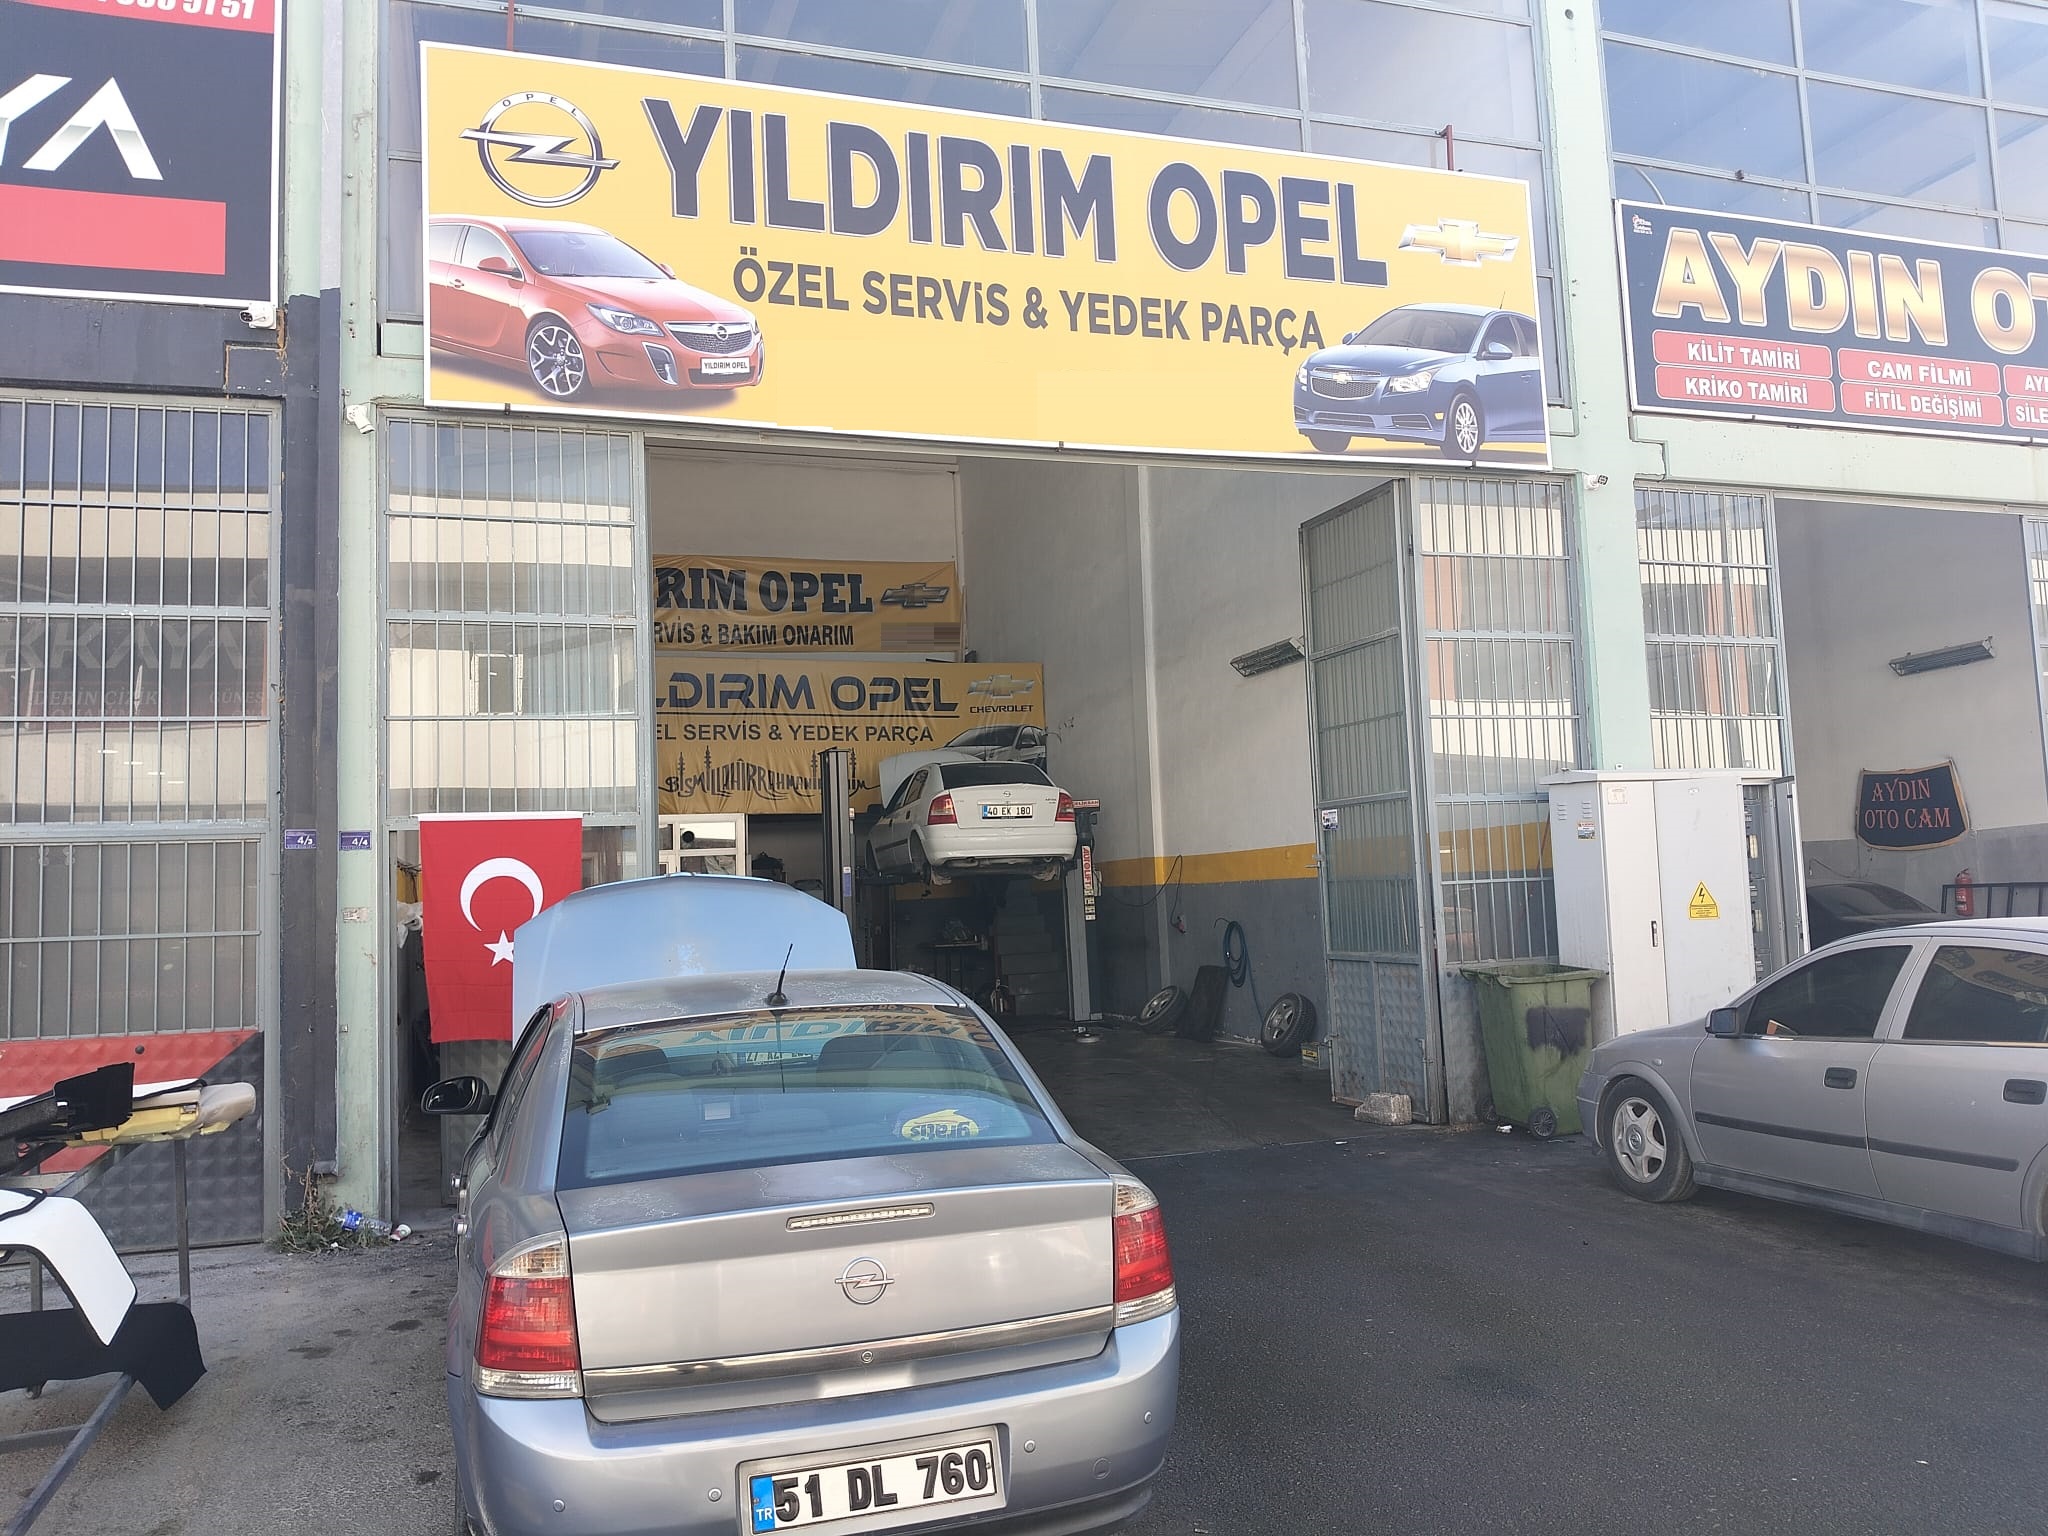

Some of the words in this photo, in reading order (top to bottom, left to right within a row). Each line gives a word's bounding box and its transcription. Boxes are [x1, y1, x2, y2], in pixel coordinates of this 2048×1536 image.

[502, 93, 578, 117] OPEL
[640, 97, 1118, 263] YILDIRIM
[1148, 161, 1390, 288] OPEL
[1651, 226, 1948, 347] AYDIN
[733, 246, 849, 310] ÖZEL
[1022, 286, 1048, 329] &
[1058, 289, 1191, 341] YEDEK
[1201, 303, 1325, 357] PARÇA
[732, 361, 748, 369] OPEL
[1687, 340, 1735, 363] KİLİT
[1740, 347, 1801, 370] TAMİRİ
[1867, 361, 1912, 381] CAM
[1918, 363, 1972, 386] FİLMİ
[1685, 375, 1743, 398] KRİKO
[1747, 381, 1808, 404] TAMİRİ
[1864, 388, 1907, 411] FİTİL
[1911, 393, 1982, 420] DEĞİŞİMİ
[758, 570, 874, 613] OPEL
[701, 624, 712, 644] &
[783, 624, 854, 646] ONARIM
[830, 676, 960, 712] OPEL
[969, 704, 1034, 714] CHEVROLET
[683, 720, 761, 741] SERVİS
[768, 724, 783, 741] &
[788, 724, 859, 742] YEDEK
[866, 725, 934, 745] PARÇA
[1871, 777, 1931, 801] AYDIN
[1001, 807, 1012, 815] EK
[1864, 809, 1899, 829] OTO
[1904, 808, 1951, 829] CAM
[351, 836, 368, 847] 4/4
[773, 1474, 823, 1522] 51
[847, 1464, 898, 1511] DL
[916, 1449, 989, 1499] 760
[756, 1508, 773, 1521] TR
